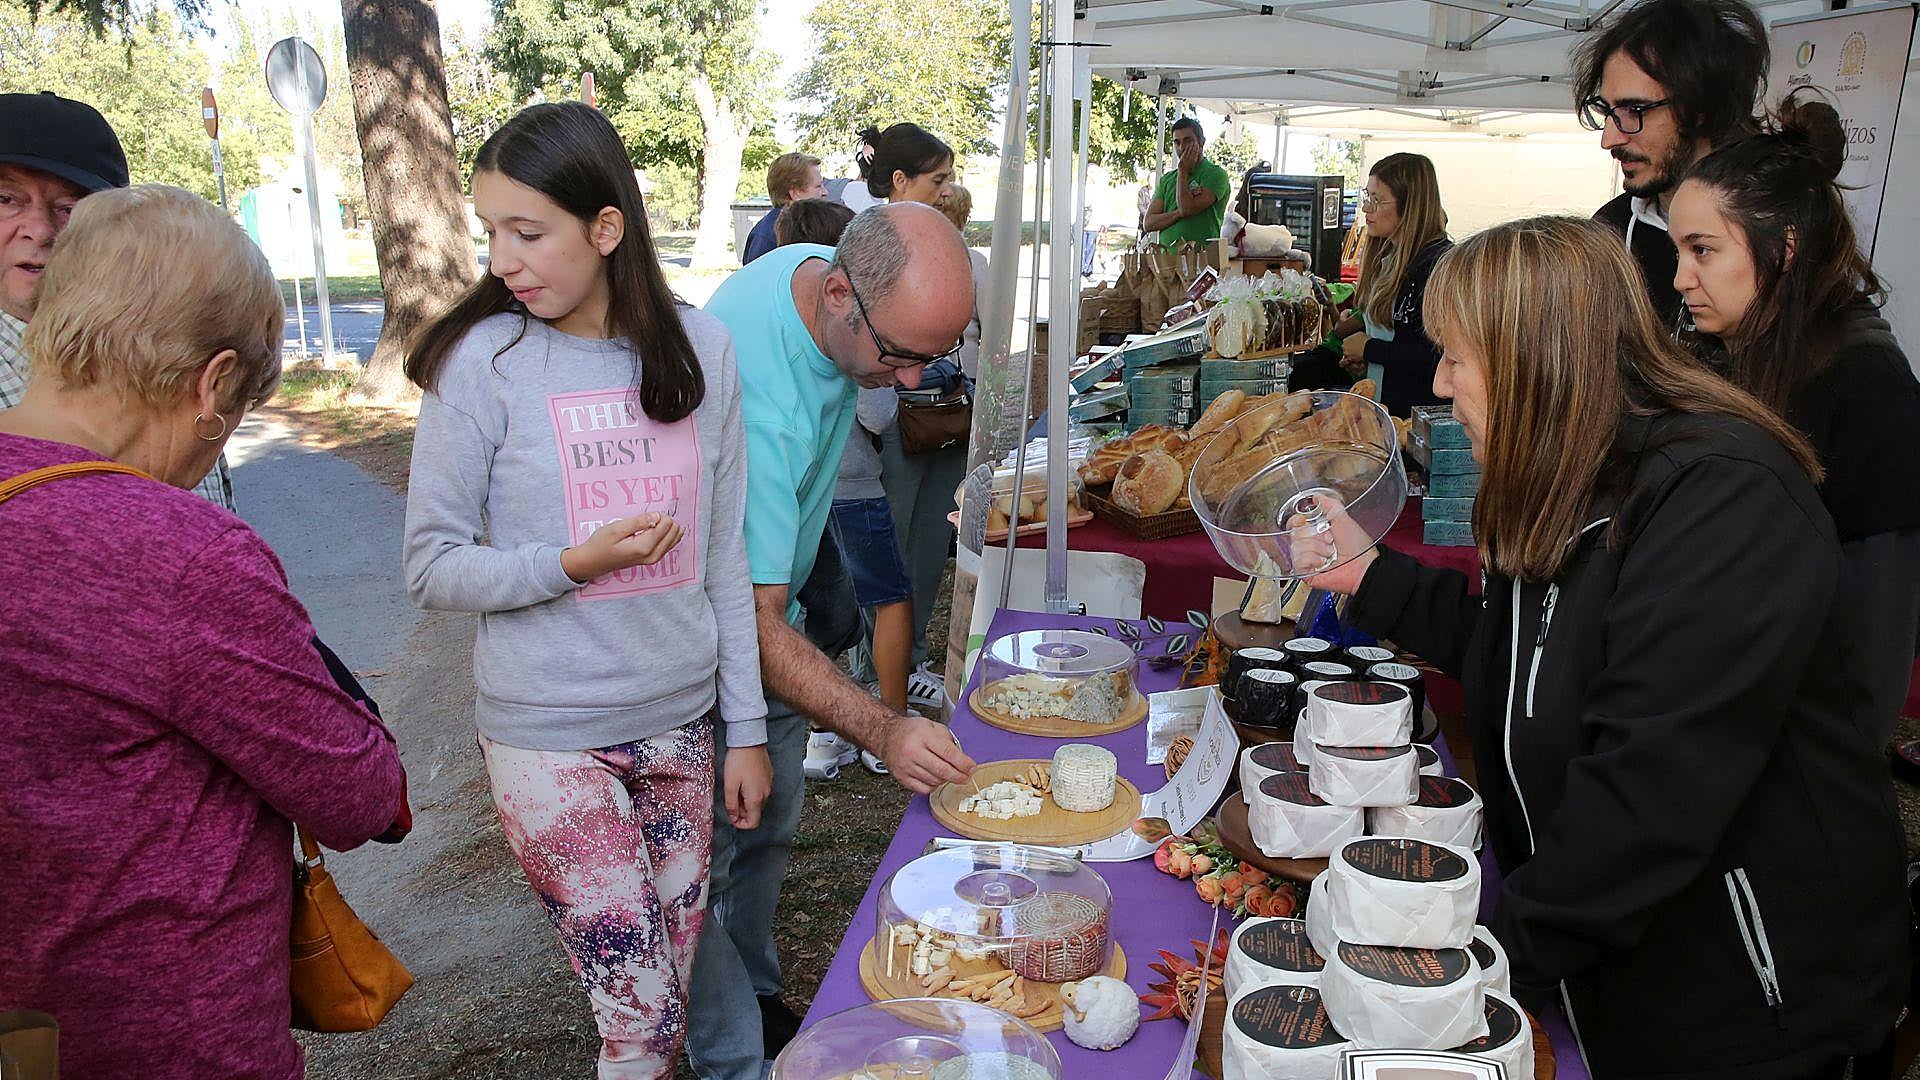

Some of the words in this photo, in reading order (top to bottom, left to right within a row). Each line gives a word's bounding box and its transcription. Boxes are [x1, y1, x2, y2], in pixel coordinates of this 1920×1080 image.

[561, 401, 639, 433] THE
[570, 438, 656, 469] BEST
[576, 480, 610, 510] IS
[616, 475, 683, 506] YET
